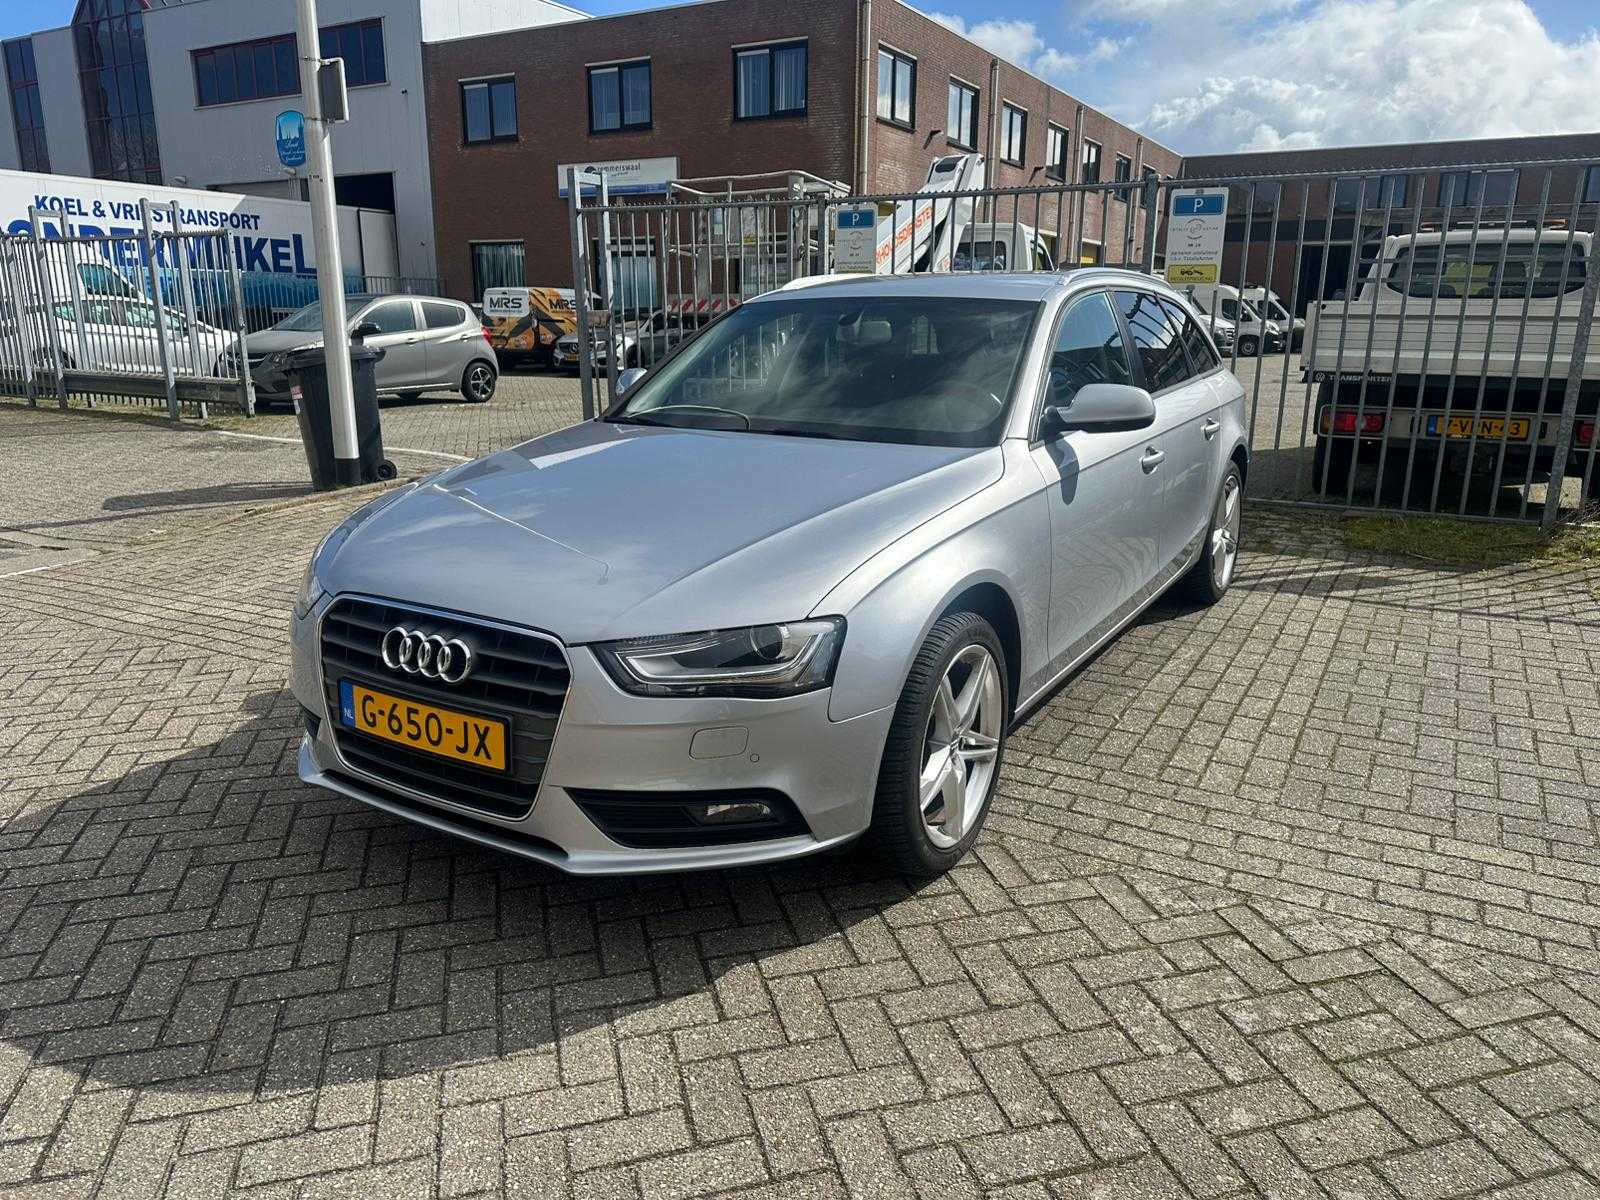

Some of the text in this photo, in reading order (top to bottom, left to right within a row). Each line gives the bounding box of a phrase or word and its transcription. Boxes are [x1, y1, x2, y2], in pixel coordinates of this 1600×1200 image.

[34, 194, 260, 230] KOEL & VRISTRANSPORT
[489, 297, 523, 309] MRS
[1329, 374, 1393, 383] TANSPRTER
[343, 707, 354, 720] NL
[361, 694, 492, 760] G-650-JX
